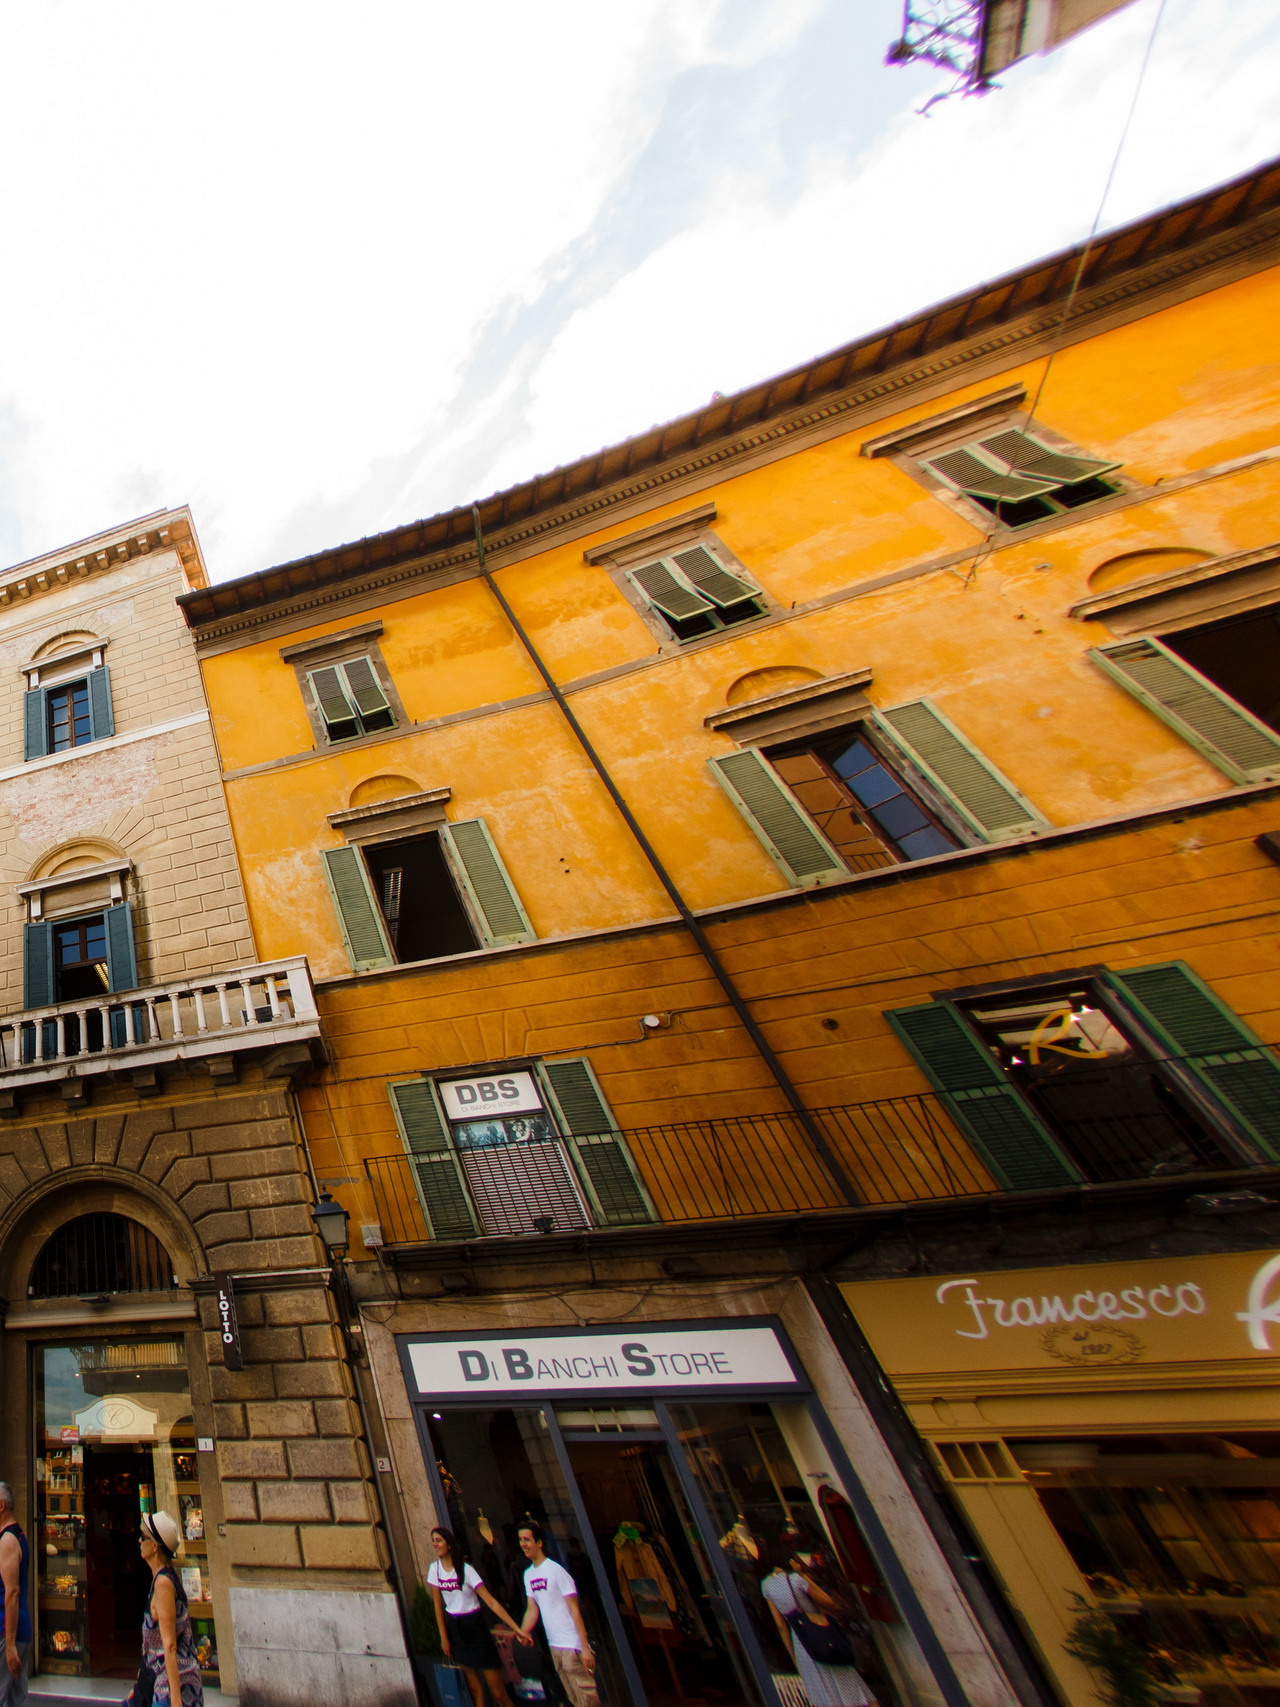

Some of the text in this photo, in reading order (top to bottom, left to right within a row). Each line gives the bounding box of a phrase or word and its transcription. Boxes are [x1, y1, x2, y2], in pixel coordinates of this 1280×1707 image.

[454, 1079, 520, 1105] DBS
[498, 1099, 521, 1108] STORE
[219, 1290, 233, 1344] LOTTO
[936, 1279, 1206, 1339] Francesco
[621, 1343, 733, 1377] STORE
[378, 1459, 385, 1470] 2
